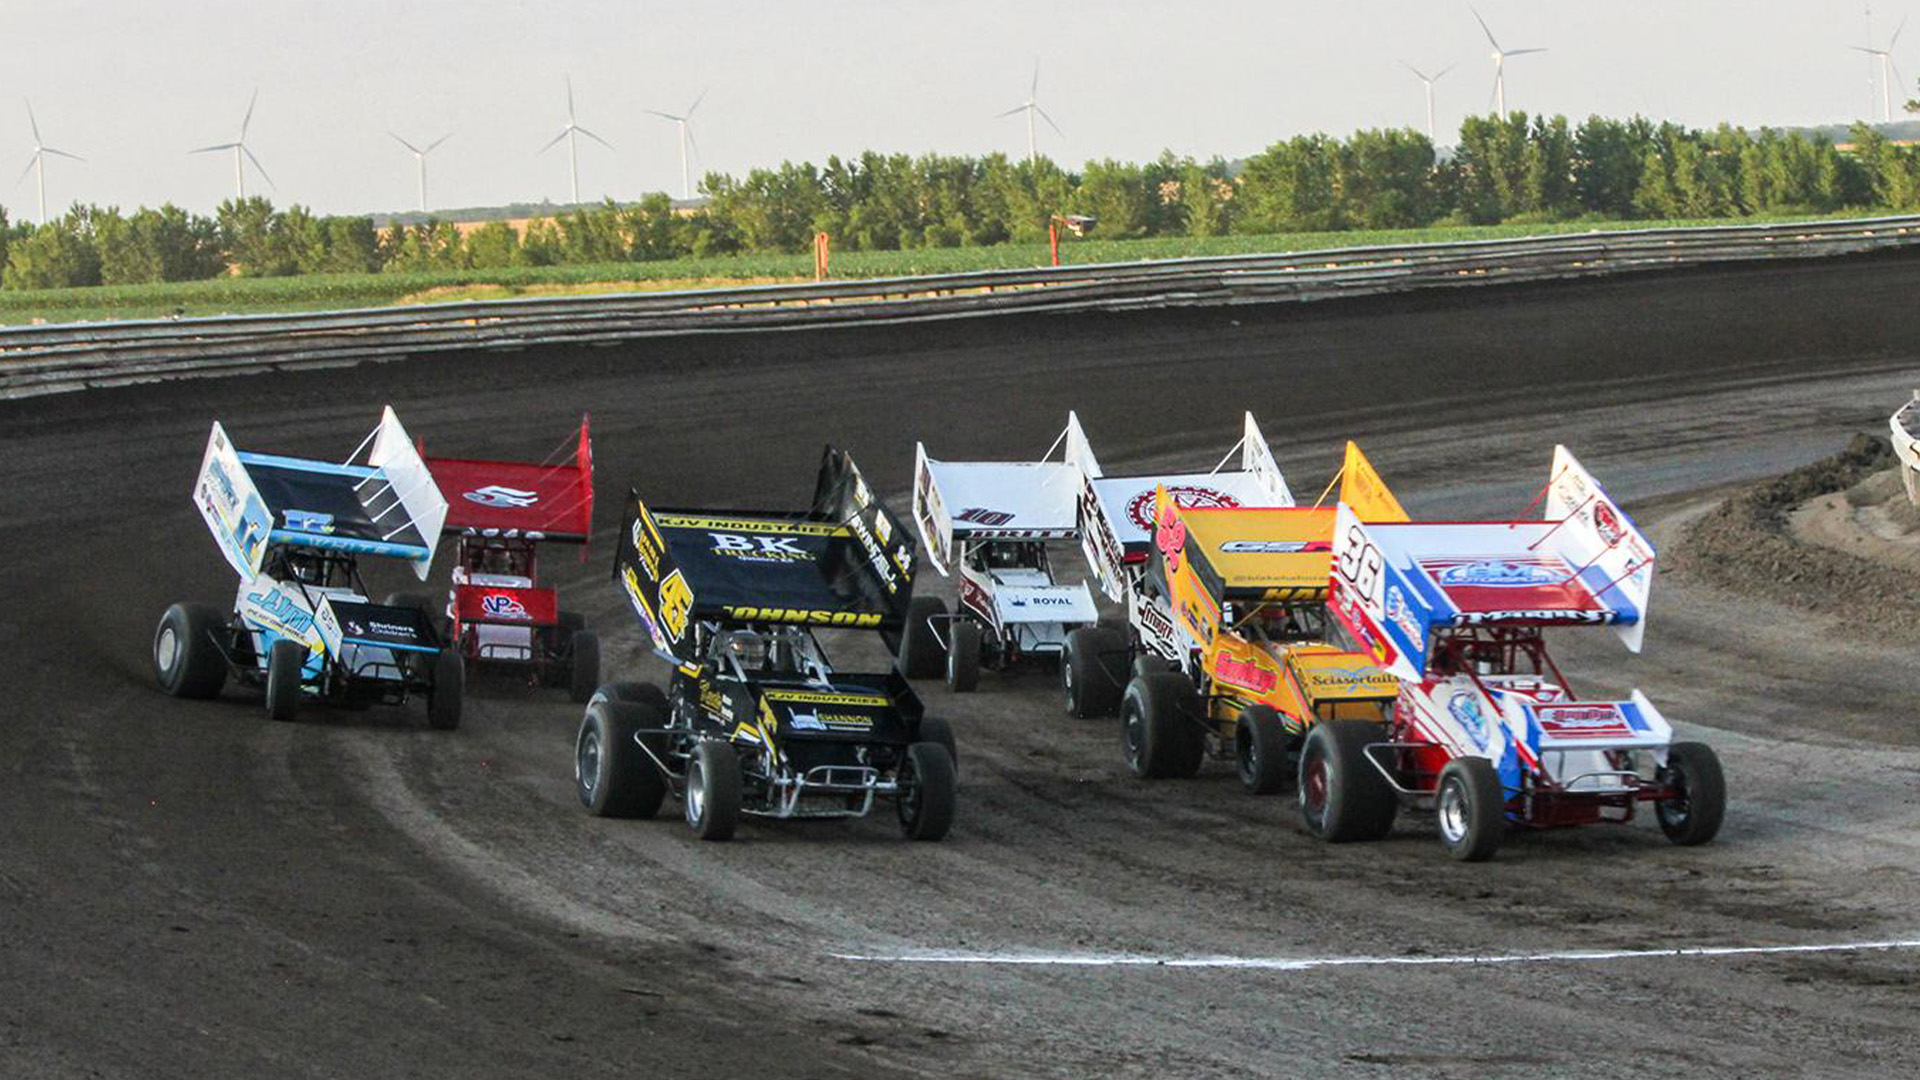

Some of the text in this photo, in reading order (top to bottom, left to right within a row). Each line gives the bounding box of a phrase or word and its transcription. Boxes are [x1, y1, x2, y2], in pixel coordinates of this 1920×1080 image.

[658, 517, 838, 534] KJV INDUSTRIES
[708, 533, 806, 553] BK
[1340, 525, 1381, 602] 36
[484, 594, 511, 613] VP
[1033, 597, 1073, 606] ROYAL
[369, 621, 415, 632] Shriners
